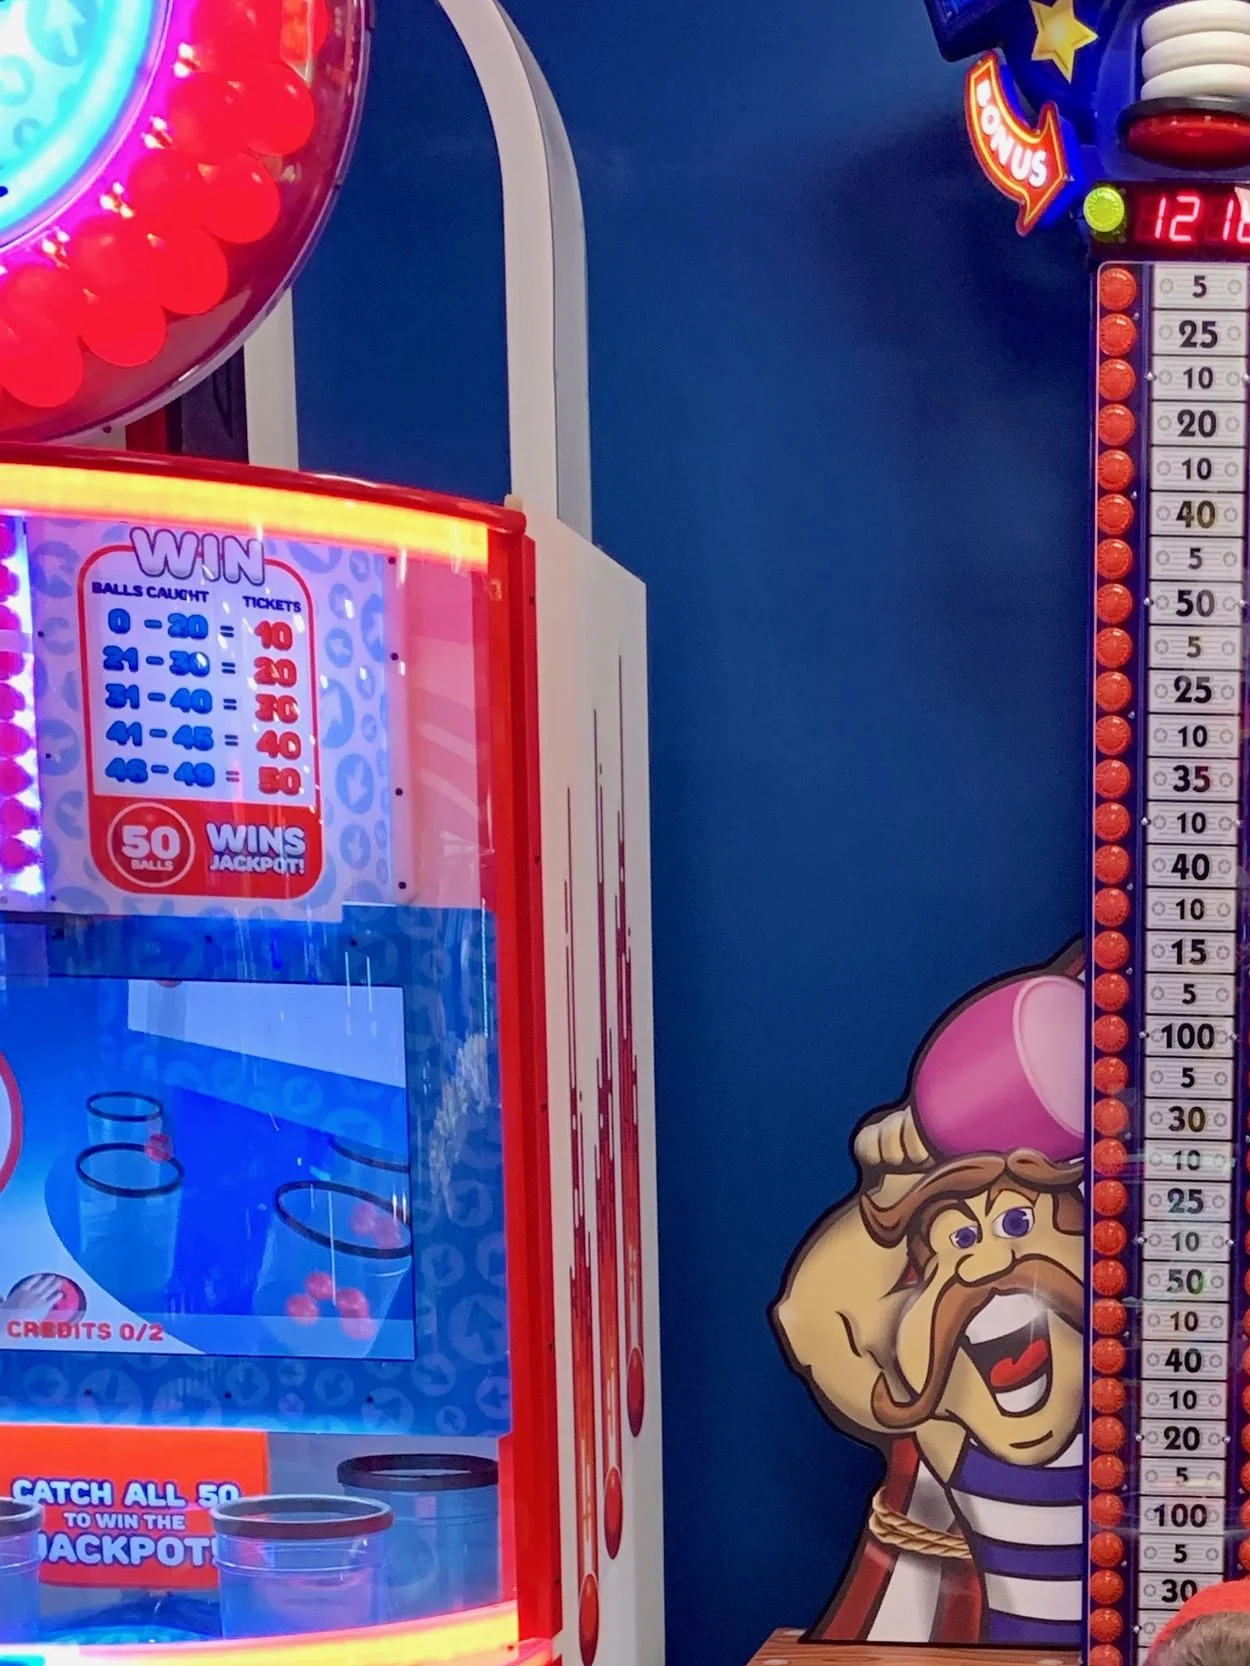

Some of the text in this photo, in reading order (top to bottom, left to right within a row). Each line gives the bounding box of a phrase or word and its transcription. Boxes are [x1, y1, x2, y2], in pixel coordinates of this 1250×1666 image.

[976, 78, 1047, 188] BONUS
[1192, 275, 1208, 299] 5
[1178, 319, 1218, 349] 25
[1183, 366, 1214, 390] 10
[1176, 409, 1217, 438] 20
[1181, 457, 1212, 481] 10
[1175, 500, 1216, 529] 40
[129, 526, 266, 586] WIN
[1188, 547, 1203, 570] 5
[91, 581, 210, 603] BALLS CAUGHT
[242, 595, 302, 613] TICKETS
[1175, 589, 1215, 618] 50
[1186, 635, 1202, 659] 5
[1173, 675, 1213, 705] 25
[1177, 724, 1209, 748] 10
[1172, 764, 1211, 794] 35
[1176, 811, 1207, 835] 10
[121, 825, 182, 860] 50
[204, 820, 307, 857] WINS
[130, 859, 174, 872] BALLS
[208, 853, 306, 876] JACKPOT!
[1170, 853, 1211, 881] 40
[1175, 897, 1206, 921] 10
[1170, 938, 1208, 966] 15
[1181, 983, 1197, 1006] 5
[1160, 1022, 1216, 1051] 100
[1180, 1066, 1196, 1089] 5
[1167, 1105, 1207, 1133] 30
[1172, 1149, 1202, 1172] 10
[1167, 1187, 1205, 1215] 25
[1171, 1231, 1200, 1252] 10
[1168, 1268, 1204, 1295] 50
[7, 1320, 165, 1342] CREDITS 0/2
[1169, 1310, 1199, 1333] 10
[1164, 1347, 1203, 1374] 40
[1168, 1389, 1198, 1411] 10
[1163, 1425, 1201, 1452] 20
[1175, 1466, 1190, 1487] 5
[11, 1477, 241, 1509] CATCH ALL 50
[63, 1511, 187, 1531] TO WIN THE
[1152, 1503, 1209, 1529] 100
[1172, 1543, 1188, 1564] 5
